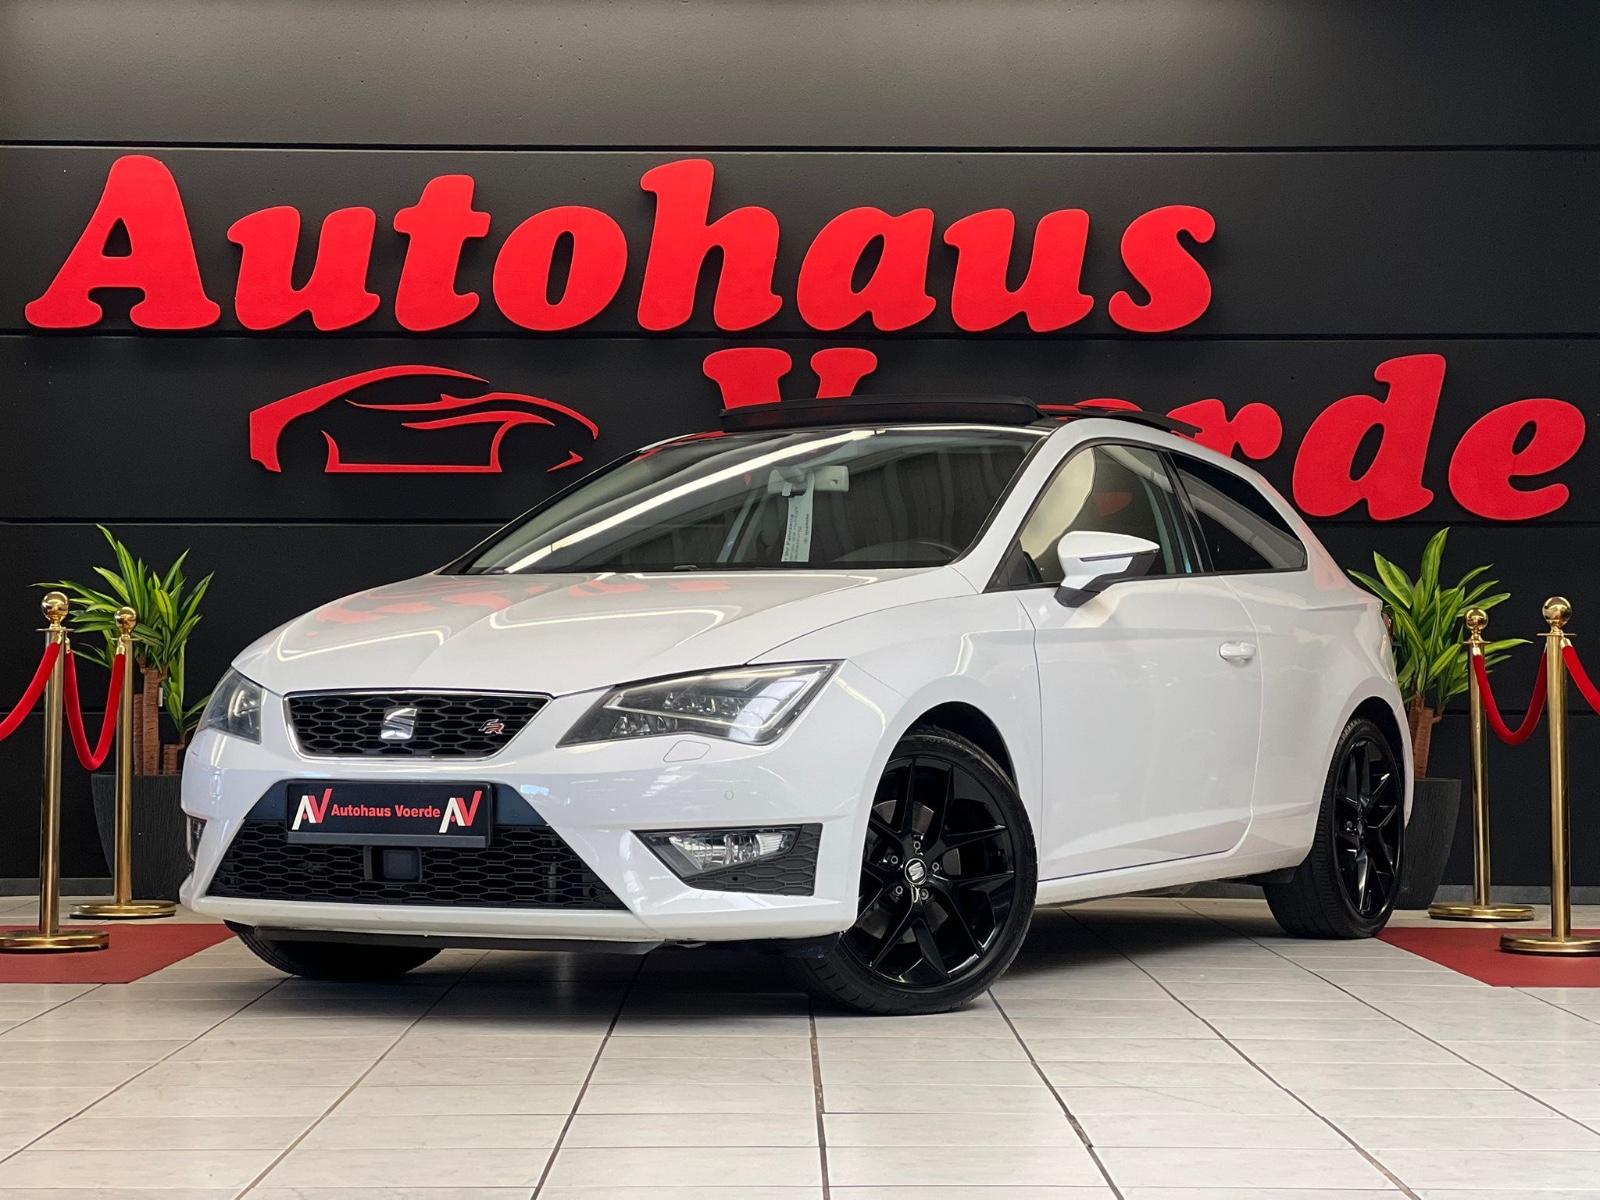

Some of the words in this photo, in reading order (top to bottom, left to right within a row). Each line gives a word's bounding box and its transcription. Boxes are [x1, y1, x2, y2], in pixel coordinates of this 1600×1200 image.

[25, 155, 1217, 333] Autohaus
[331, 803, 391, 818] Autohaus
[394, 804, 441, 819] Voerde
